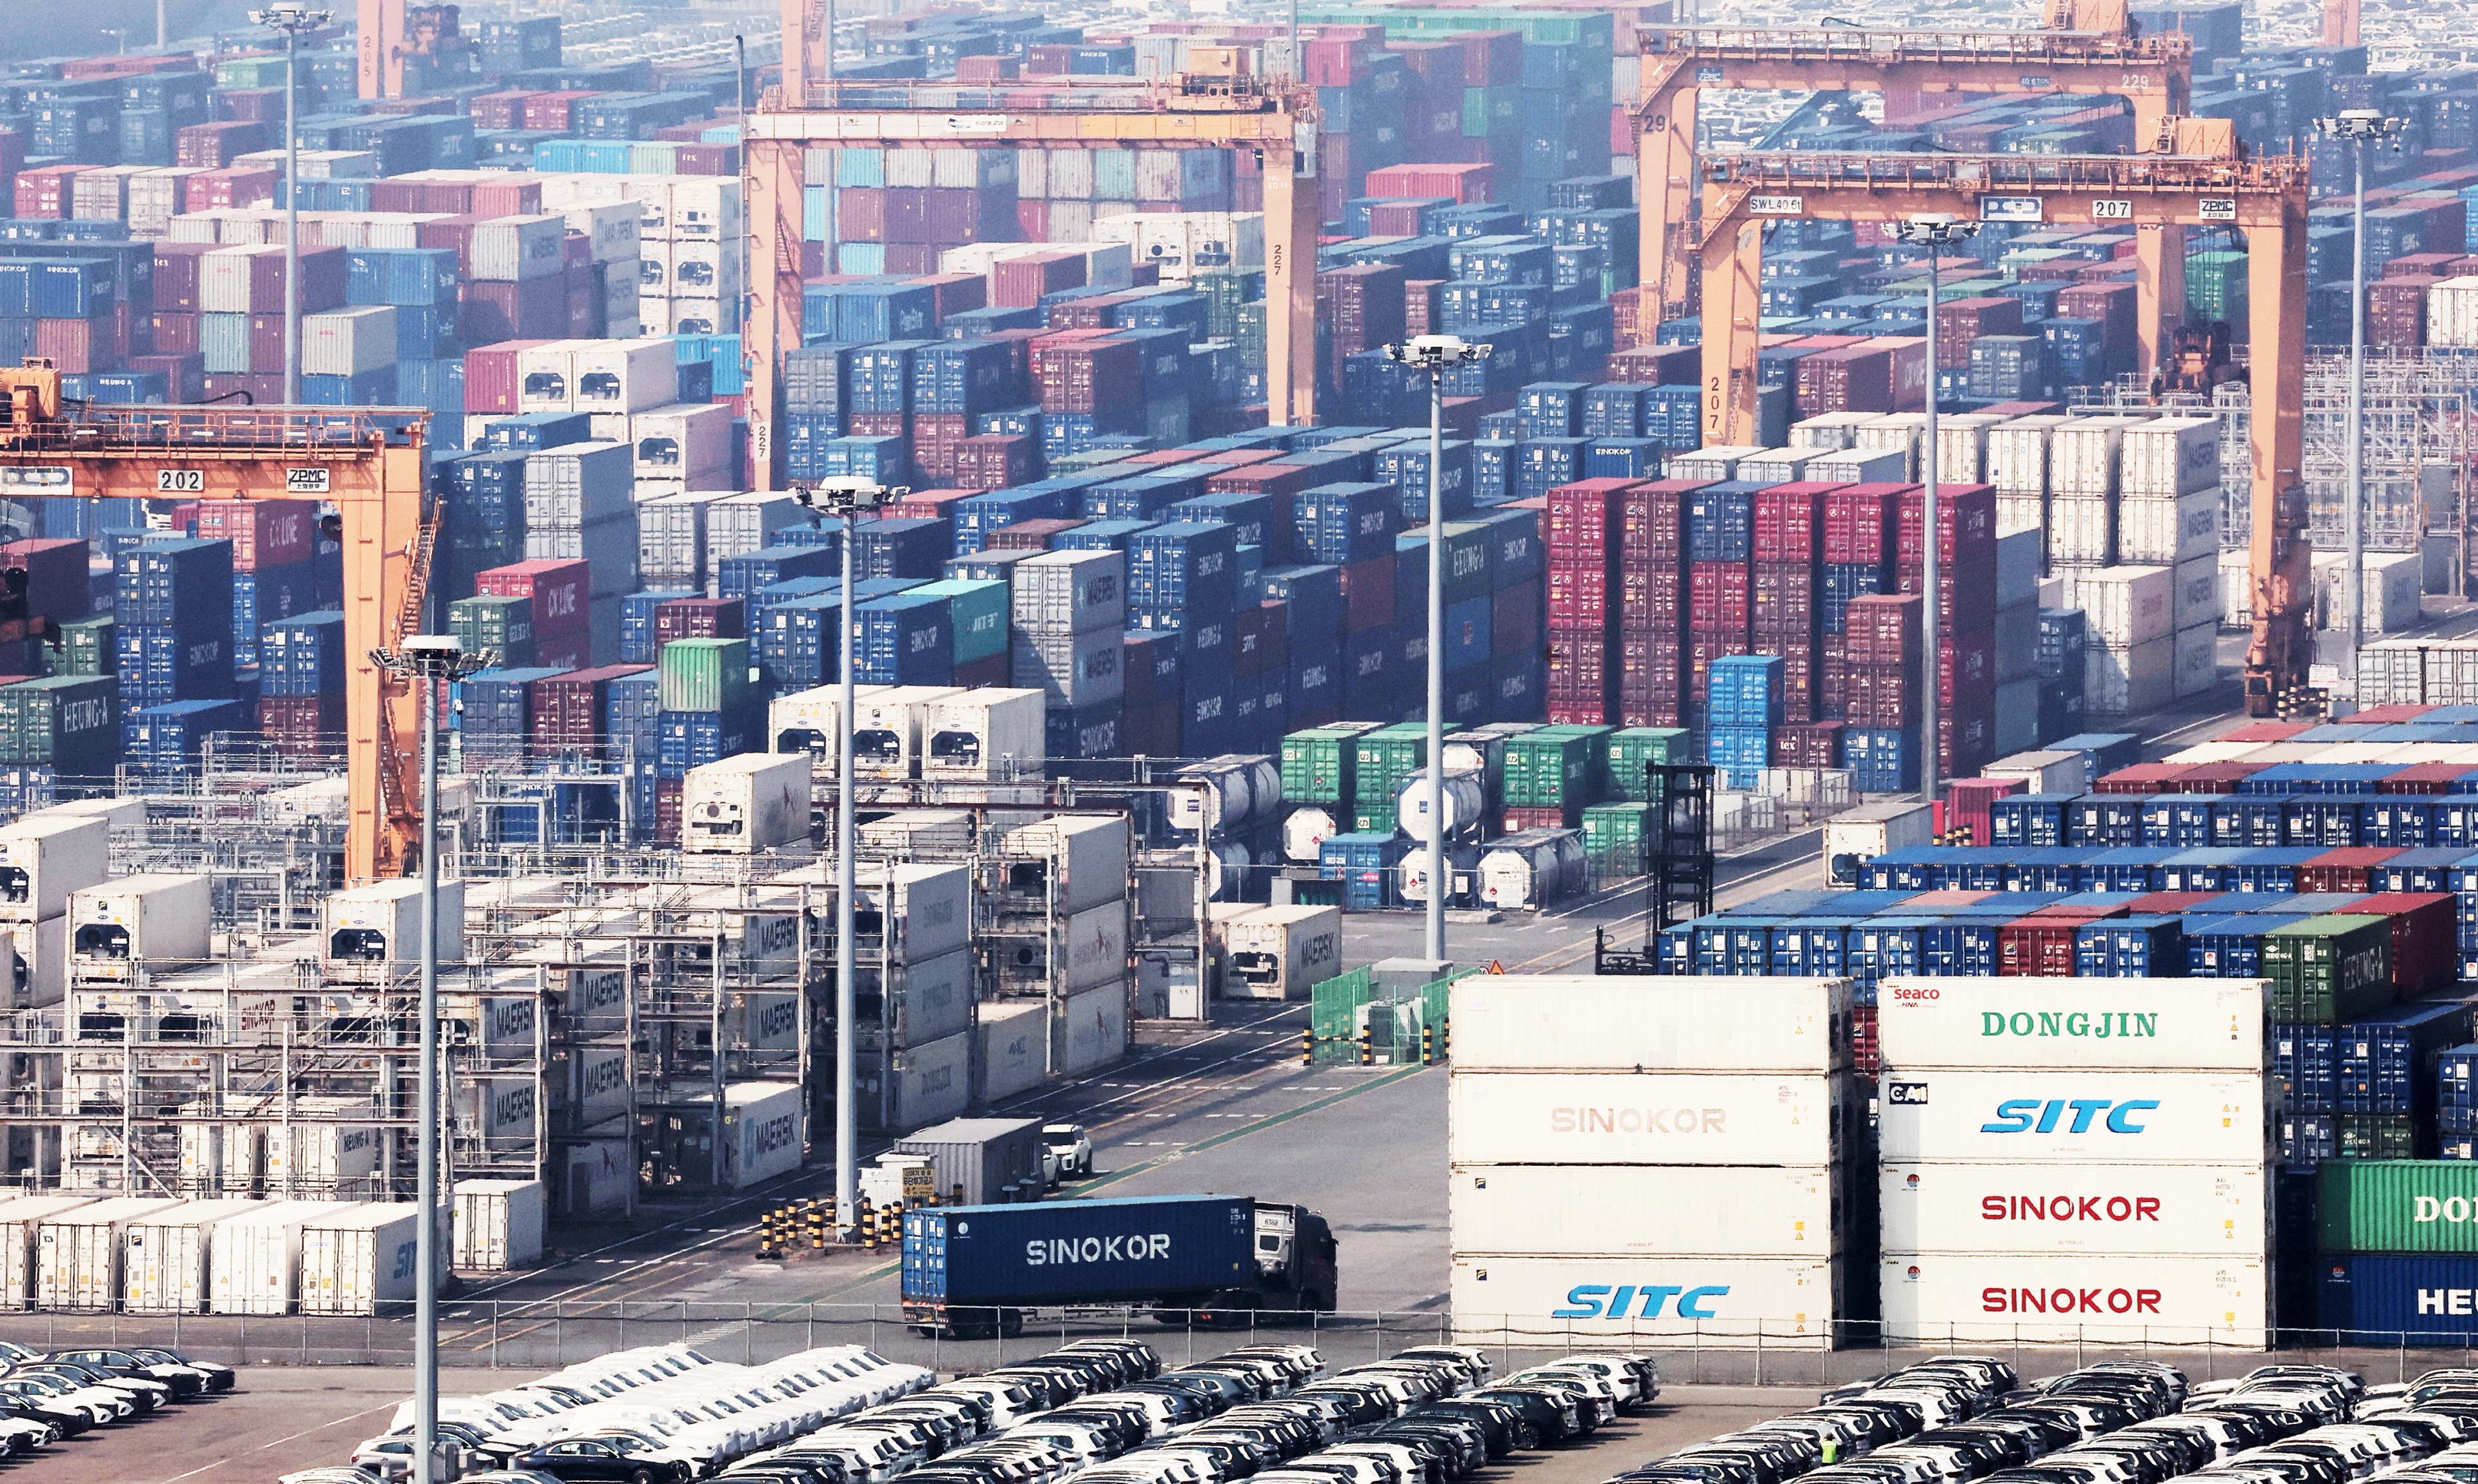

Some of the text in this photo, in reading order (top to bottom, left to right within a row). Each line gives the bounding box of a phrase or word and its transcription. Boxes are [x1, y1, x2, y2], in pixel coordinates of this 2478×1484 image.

[2121, 75, 2149, 89] 229
[2095, 201, 2129, 217] 207
[2201, 201, 2233, 212] ZPMC
[1045, 363, 1059, 372] tex
[1709, 376, 1719, 429] 207
[161, 472, 199, 490] 202
[288, 472, 327, 483] ZPMC
[64, 696, 108, 733] HEUNG-A
[1780, 740, 1796, 750] tex
[761, 916, 798, 954] MAERSK
[1301, 932, 1334, 967] MAERSK
[2344, 945, 2384, 991] HEUNG-A
[585, 970, 625, 1012] MAERSK
[1894, 988, 1940, 999] seaco
[496, 998, 536, 1039] MAERSK
[760, 998, 798, 1039] MAERSK
[1981, 1012, 2159, 1038] DONGJIN
[585, 1055, 626, 1099] MAERSK
[496, 1085, 536, 1127] MAERSK
[1890, 1085, 1927, 1102] CAI
[1551, 1107, 1726, 1134] SINOKOR
[1980, 1099, 2161, 1134] SITC
[755, 1112, 795, 1156] MAERSK
[1982, 1196, 2161, 1222] SINOKOR
[2414, 1196, 2478, 1224] DO
[394, 1240, 418, 1280] SIT
[1026, 1234, 1171, 1266] SINOKOR
[1551, 1285, 1731, 1319] SITC
[1982, 1288, 2162, 1314] SINOKOR
